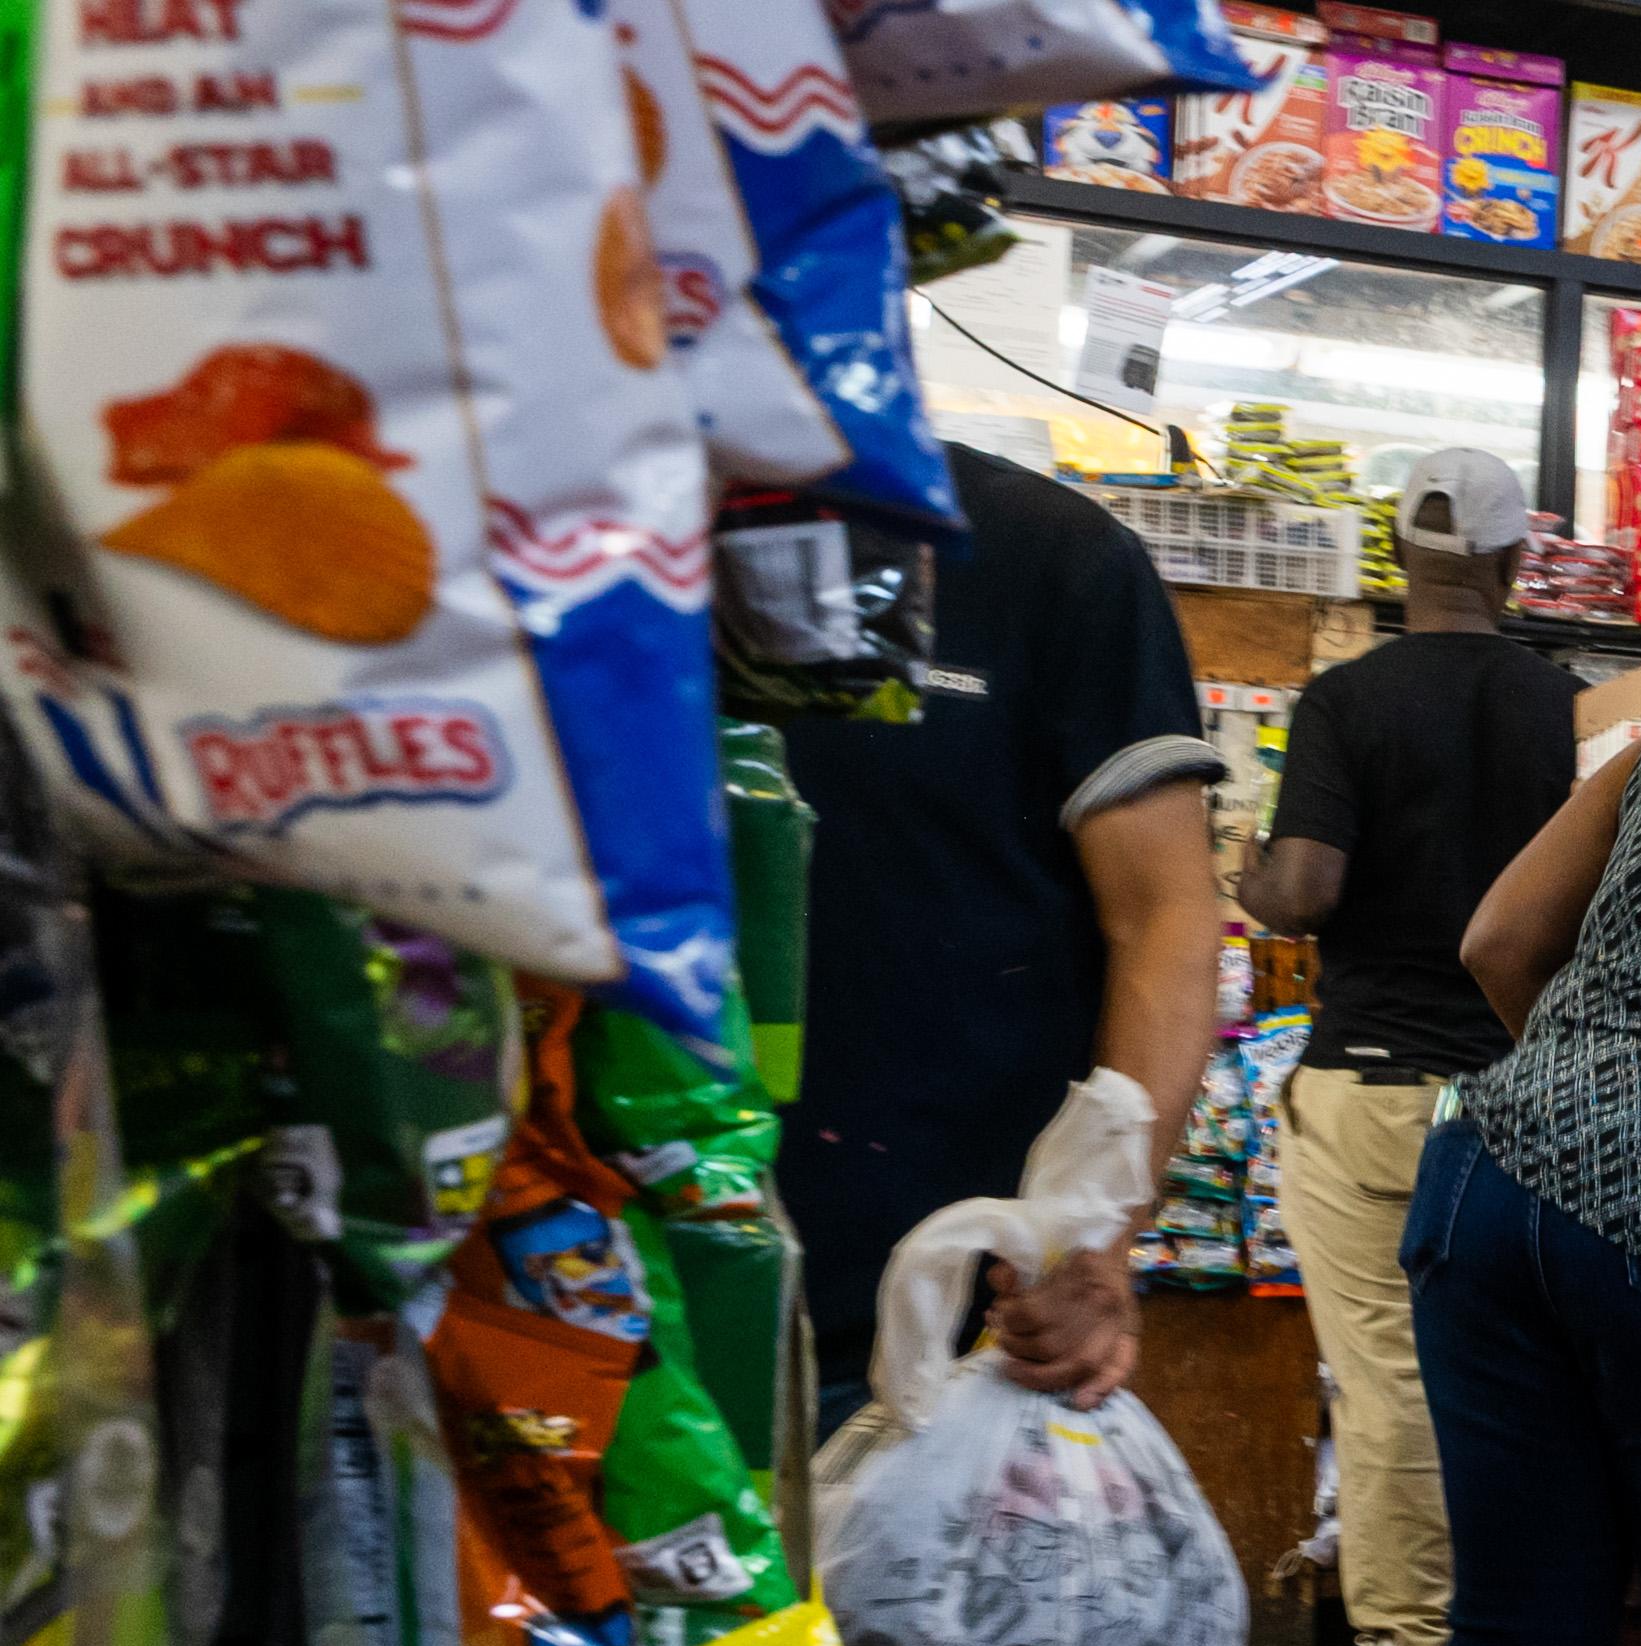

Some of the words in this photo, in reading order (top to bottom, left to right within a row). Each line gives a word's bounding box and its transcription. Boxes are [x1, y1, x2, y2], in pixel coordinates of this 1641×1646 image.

[63, 140, 336, 193] ALL-STAR
[54, 215, 368, 281] CRUNCH
[186, 712, 497, 822] RUFFLES
